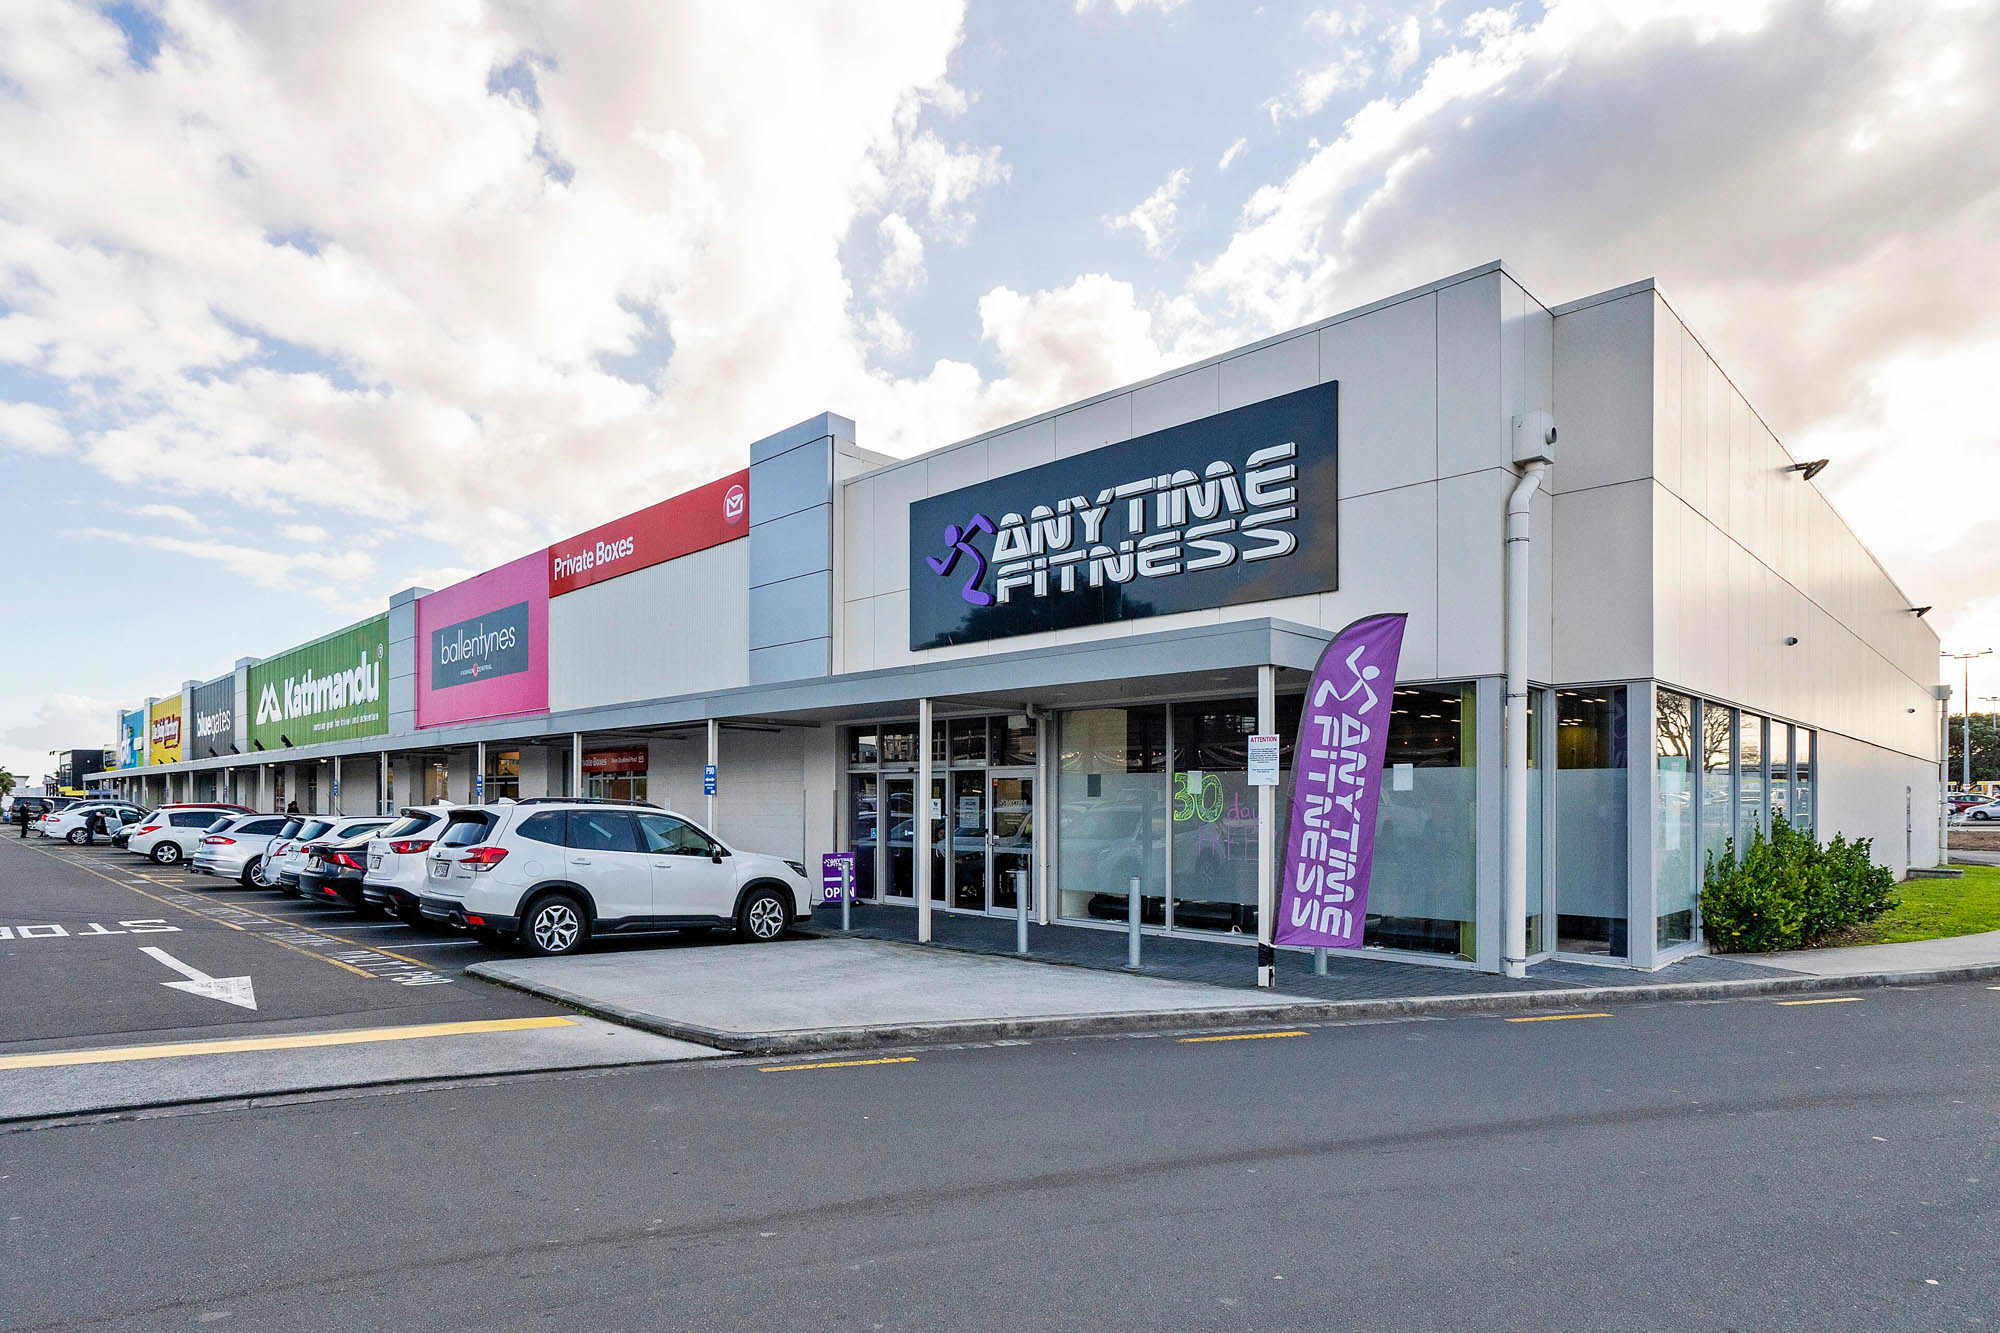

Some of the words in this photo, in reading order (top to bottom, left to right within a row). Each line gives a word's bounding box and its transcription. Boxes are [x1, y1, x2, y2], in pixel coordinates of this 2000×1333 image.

[991, 441, 1298, 563] ANYTIME
[554, 549, 594, 581] Private
[595, 536, 634, 566] Boxes
[997, 506, 1298, 604] FITNESS
[441, 622, 516, 665] ballentynes
[284, 651, 381, 720] Kathmandu
[197, 708, 231, 741] bluegates
[1173, 772, 1224, 823] 30
[1291, 715, 1340, 931] FITNESS
[1319, 712, 1370, 939] ANYTIME
